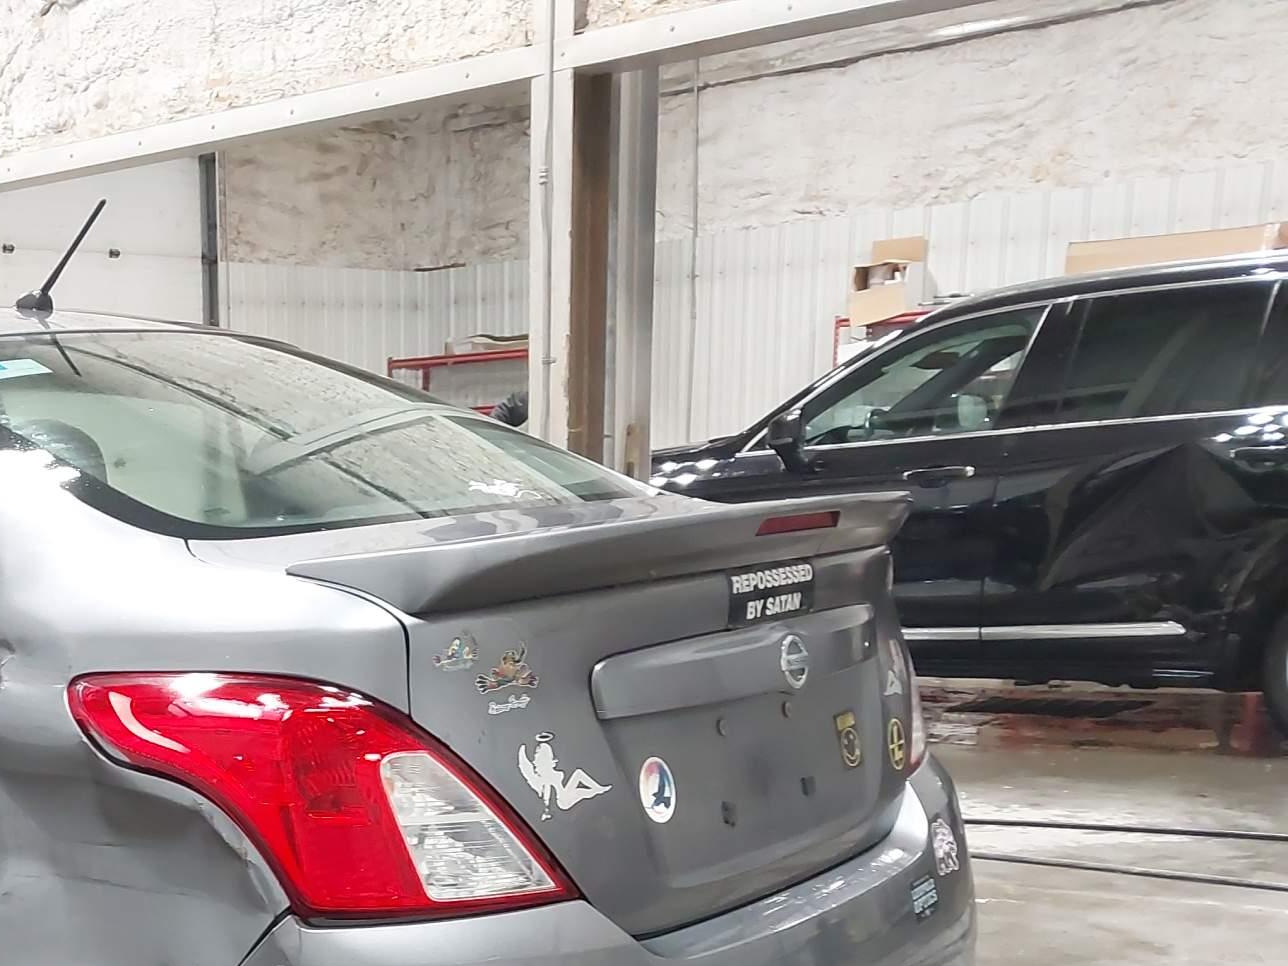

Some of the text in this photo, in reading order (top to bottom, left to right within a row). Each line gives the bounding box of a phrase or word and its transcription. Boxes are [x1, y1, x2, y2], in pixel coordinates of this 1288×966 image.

[731, 564, 813, 594] REPOSSESSED
[746, 592, 801, 619] BY SATAN
